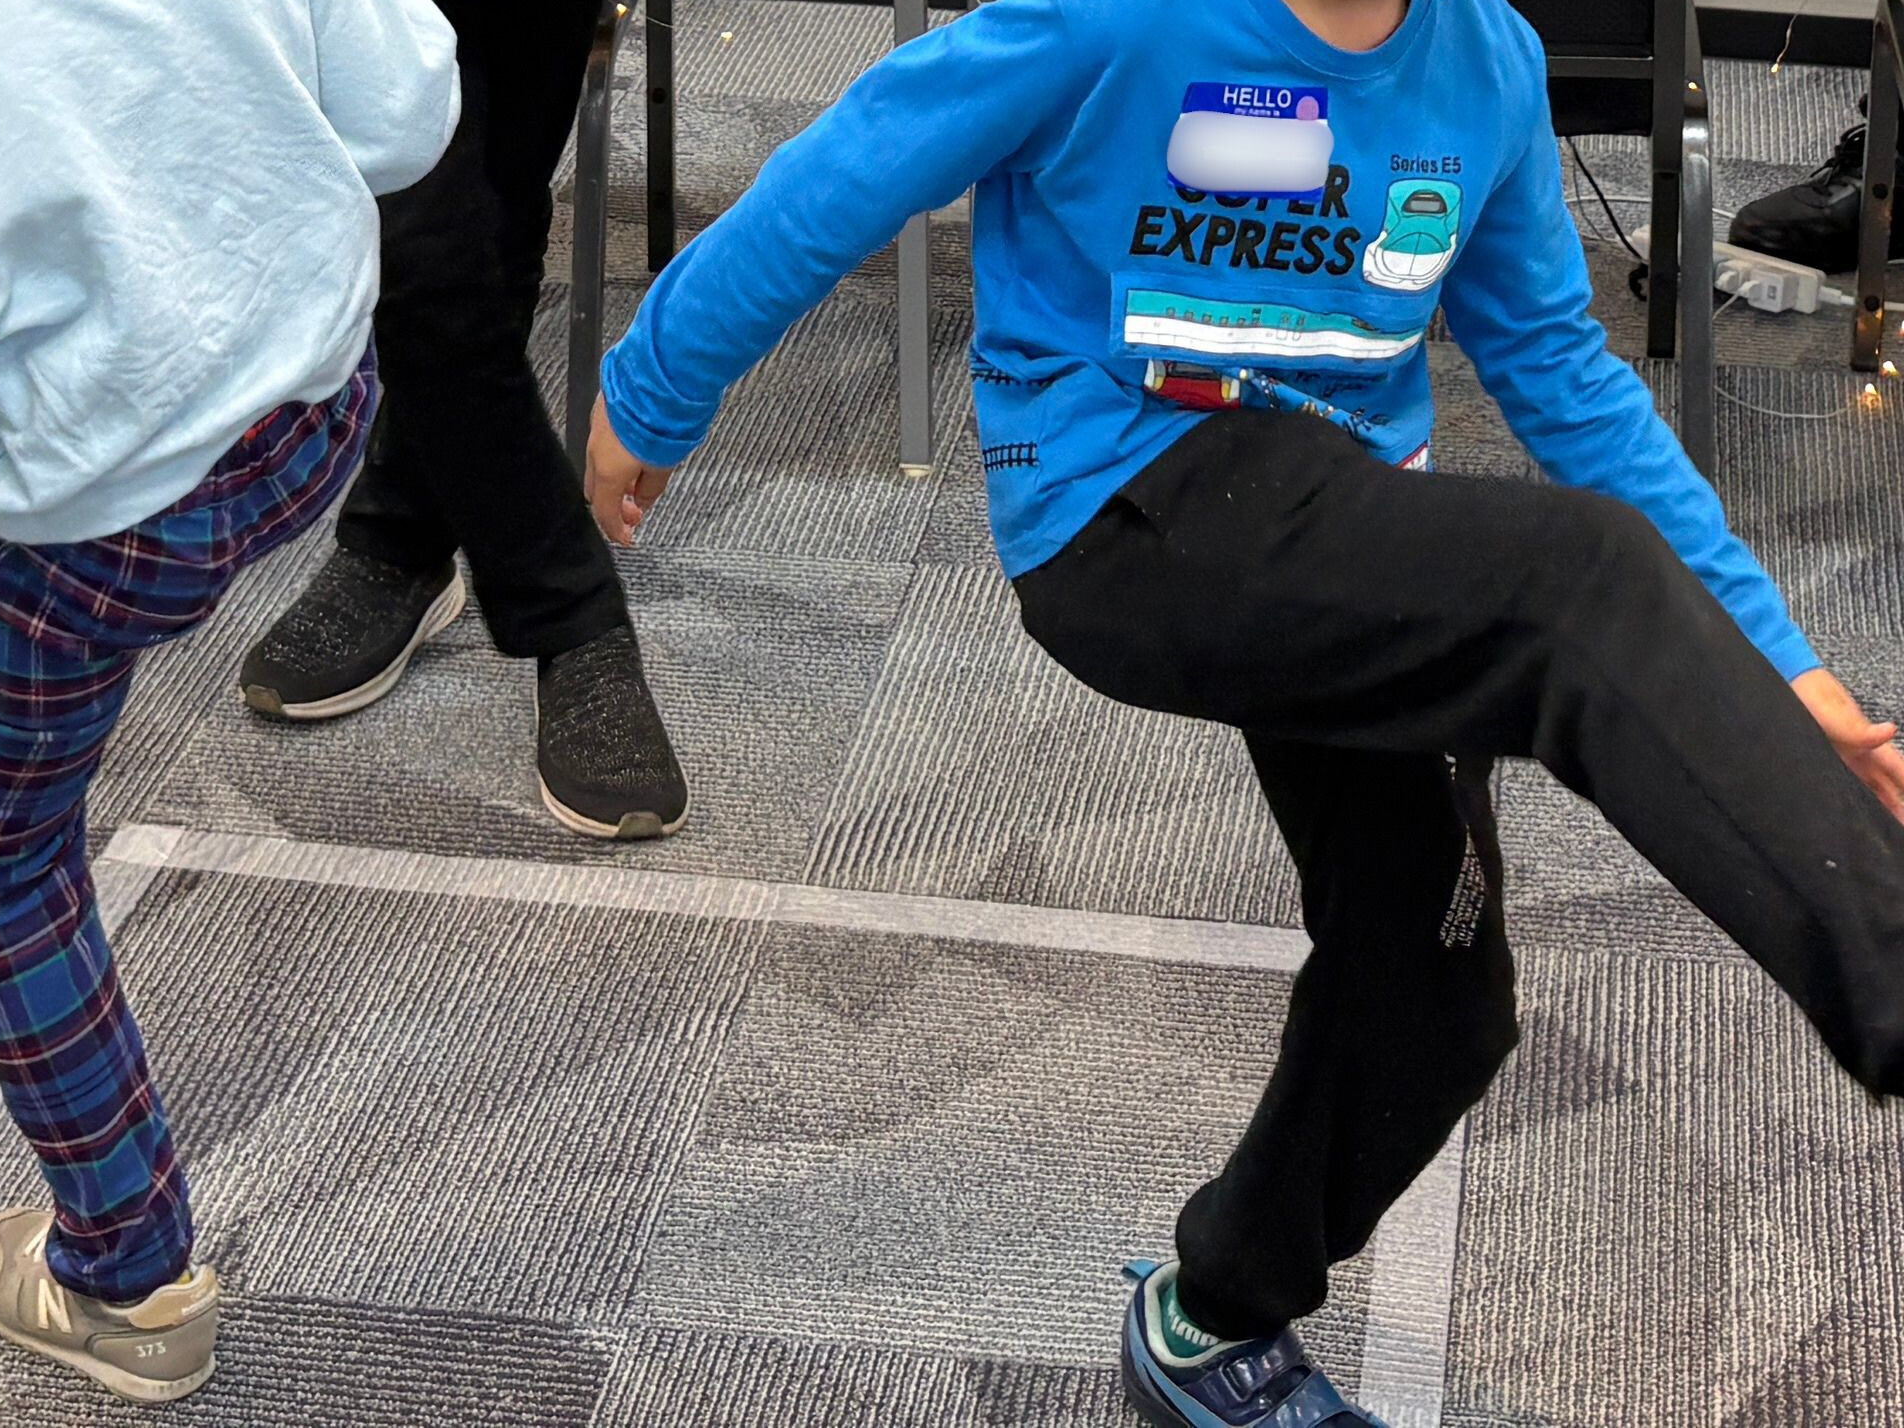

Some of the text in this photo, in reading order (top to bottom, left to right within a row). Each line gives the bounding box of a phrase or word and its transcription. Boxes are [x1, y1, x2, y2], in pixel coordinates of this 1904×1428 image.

[1223, 86, 1291, 108] HELLO
[1390, 154, 1462, 174] Series E5
[1129, 205, 1361, 276] EXPRESS
